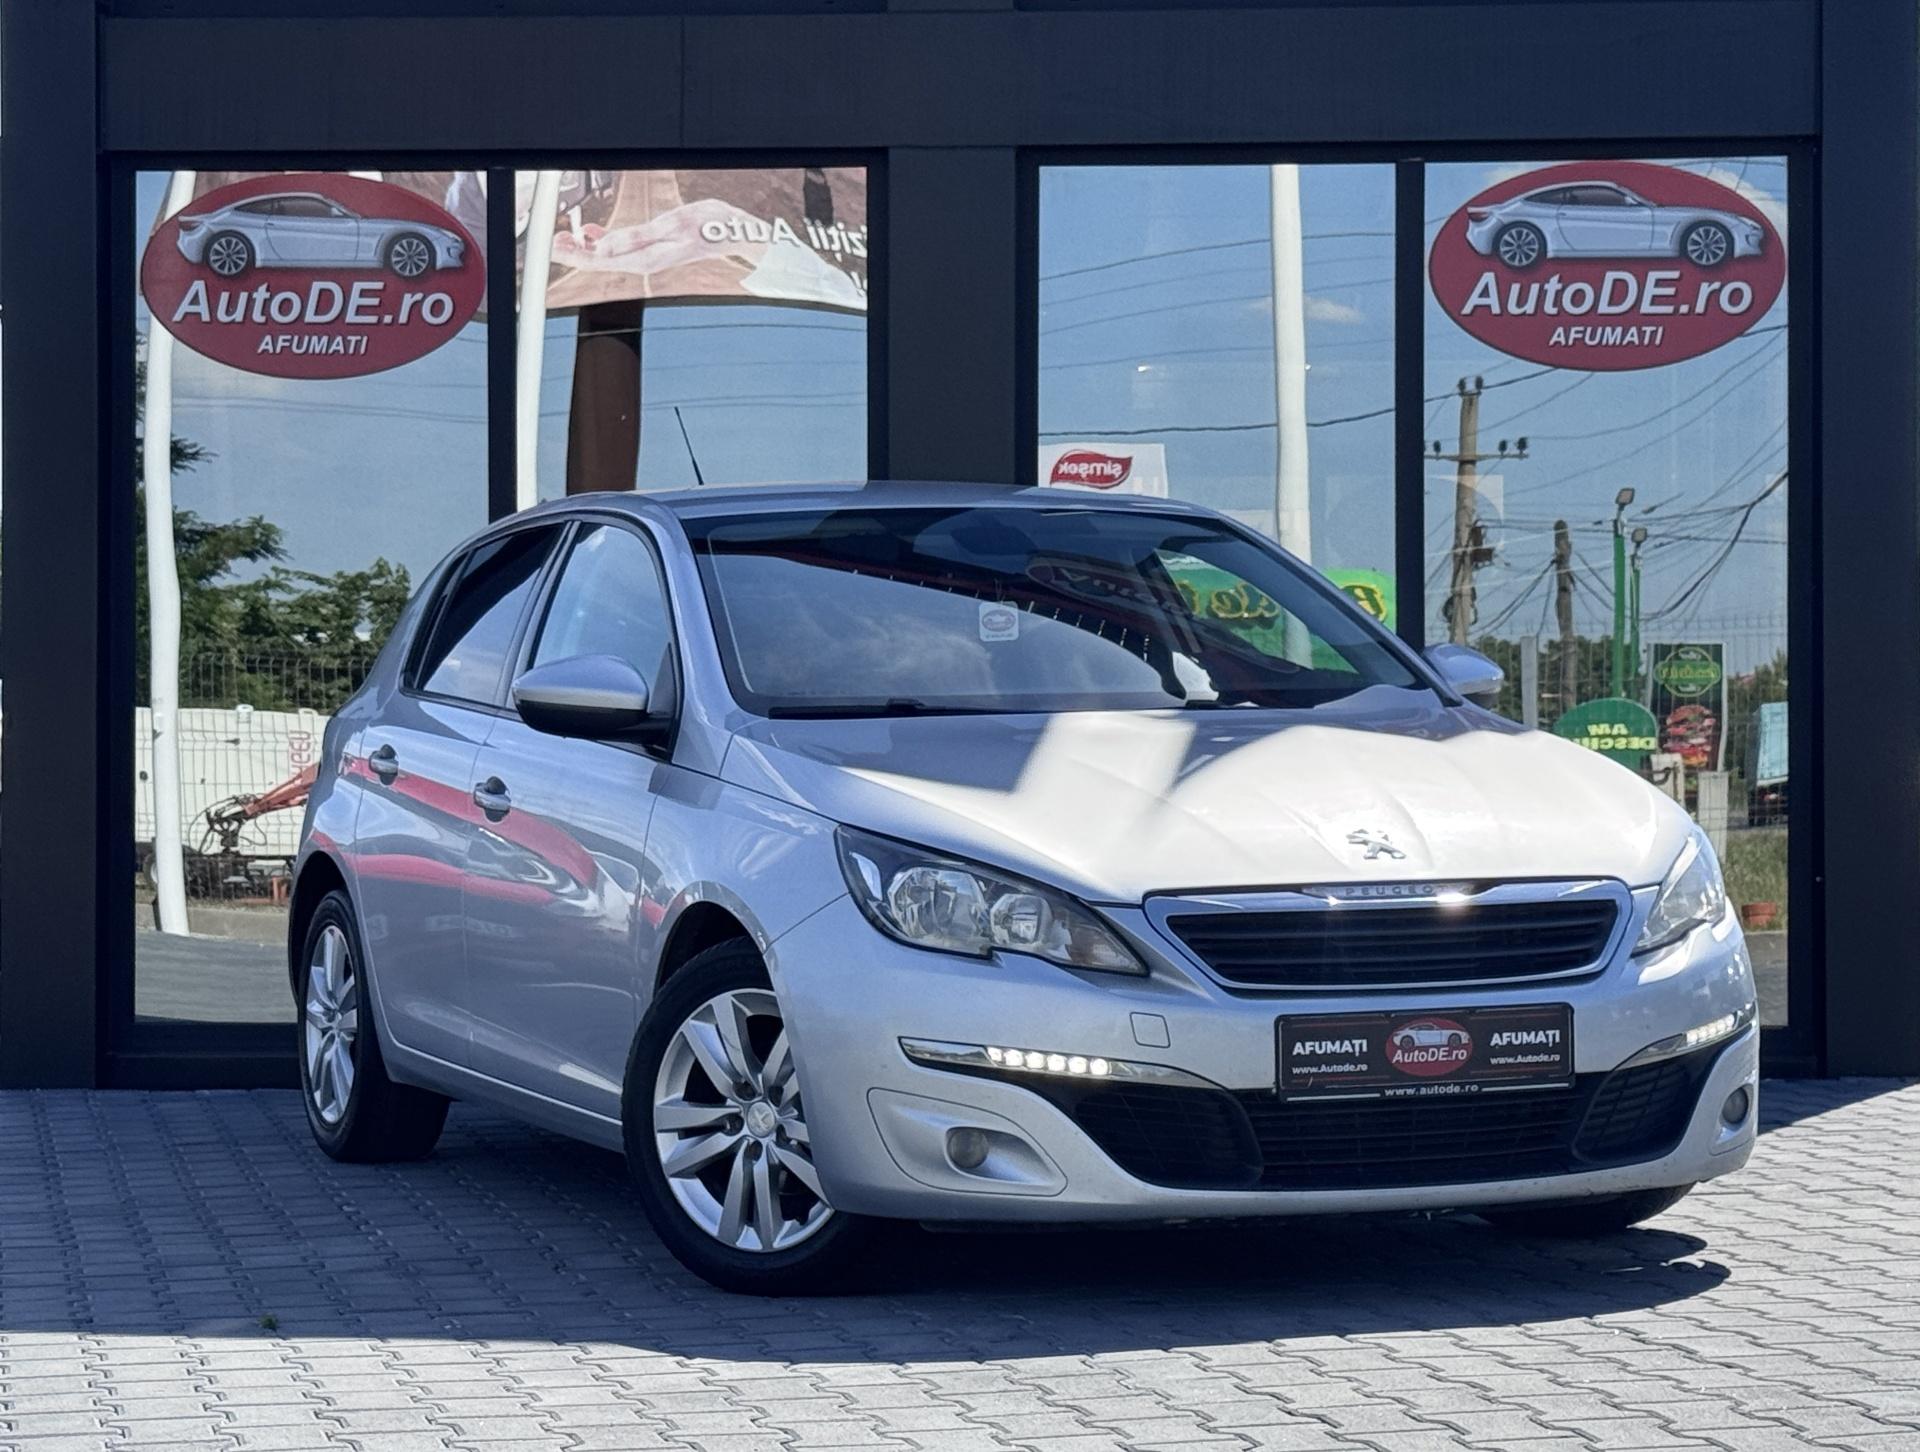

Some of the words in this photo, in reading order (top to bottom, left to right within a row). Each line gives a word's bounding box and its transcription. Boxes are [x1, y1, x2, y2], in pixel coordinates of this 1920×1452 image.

[1461, 271, 1753, 316] AutoDE.ro
[172, 280, 455, 326] AutoDE.ro
[257, 335, 369, 355] AFUMATI
[1549, 326, 1664, 347] AFUMATI
[1392, 1047, 1468, 1064] AutoDE.ro
[1490, 1053, 1560, 1065] www.Autode.ro
[1292, 1062, 1368, 1075] www.Autode.ro
[1384, 1083, 1479, 1096] www.autode.ro
